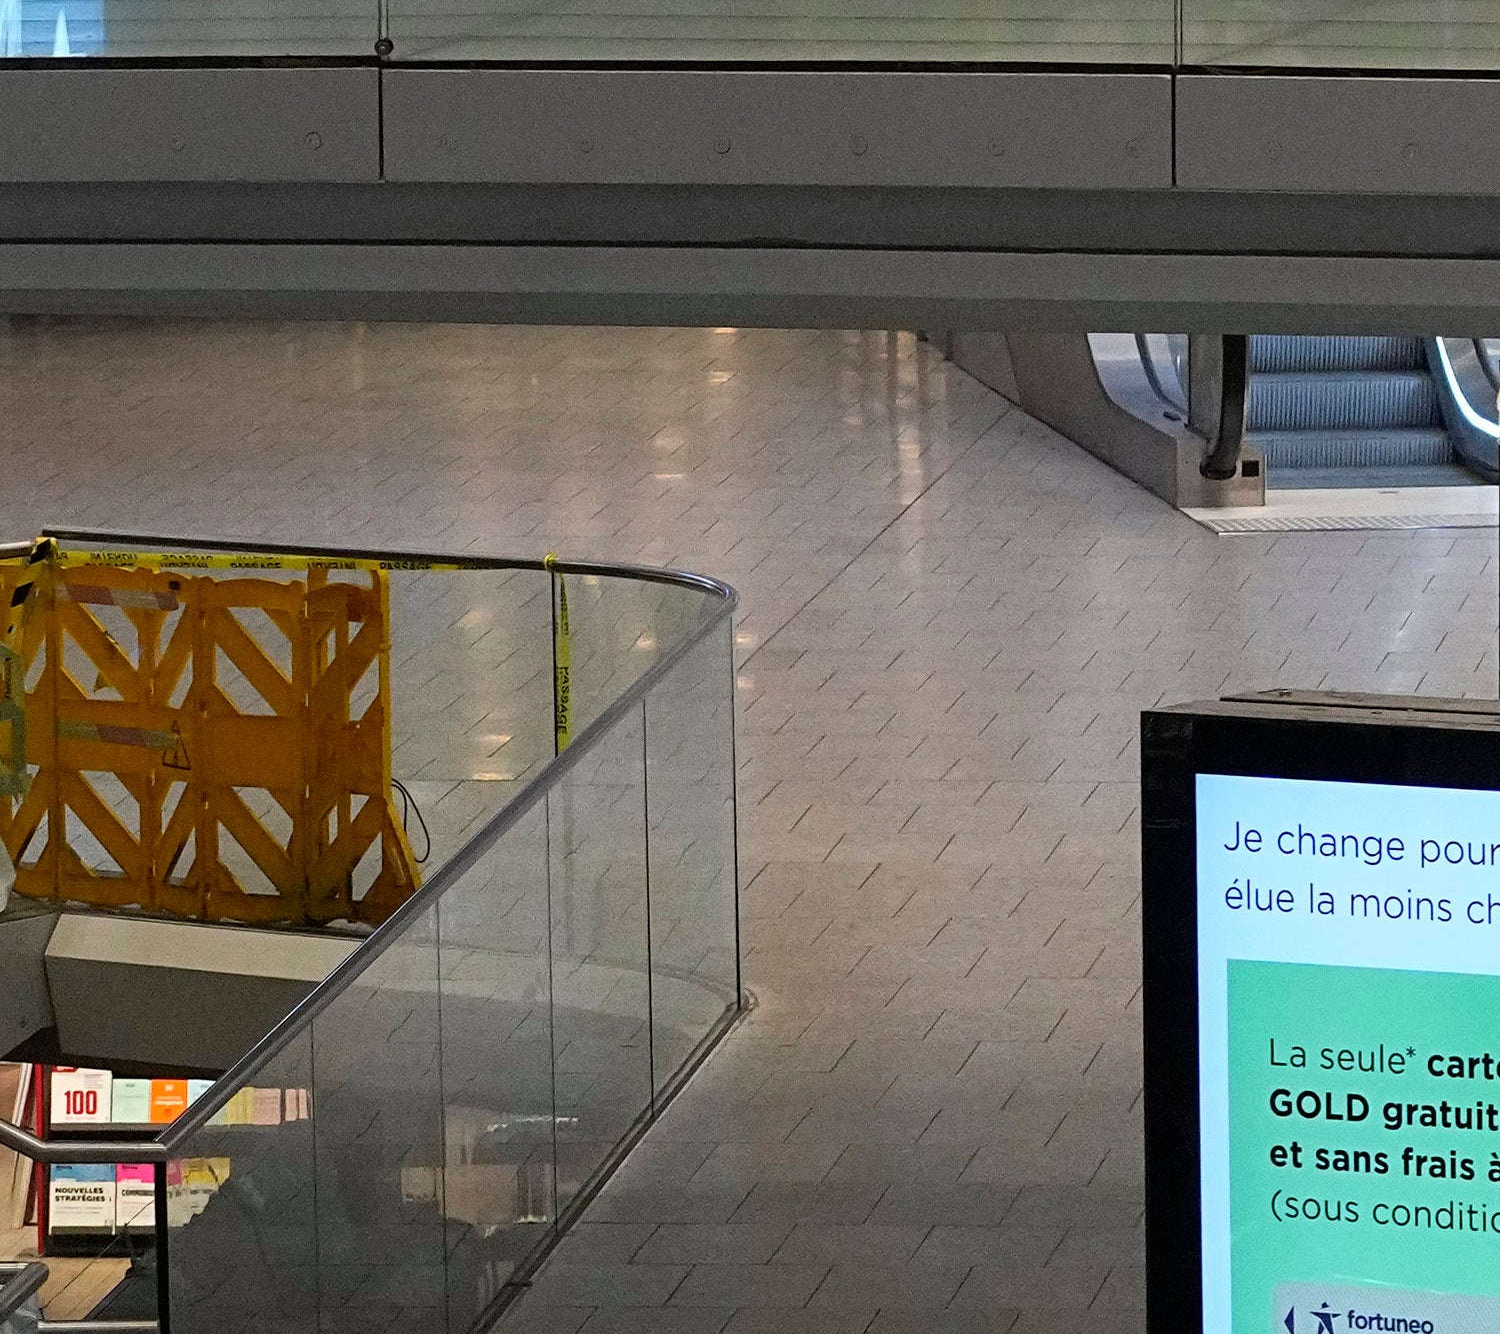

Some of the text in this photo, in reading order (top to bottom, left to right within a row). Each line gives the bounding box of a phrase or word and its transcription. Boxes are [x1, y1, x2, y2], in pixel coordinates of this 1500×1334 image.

[1224, 821, 1264, 855] Je
[1276, 824, 1406, 867] change
[1224, 878, 1295, 914] élue
[1309, 882, 1336, 916] la
[1350, 888, 1452, 925] moins
[1268, 1038, 1307, 1069] La
[64, 1090, 98, 1115] 100
[1268, 1088, 1371, 1124] GOLD
[1269, 1144, 1304, 1170] et
[1315, 1149, 1390, 1176] sans
[1401, 1150, 1475, 1182] frais
[55, 1187, 104, 1195] NOUVELLES
[55, 1193, 106, 1203] STRATÉGIES
[1269, 1189, 1361, 1226] (sous
